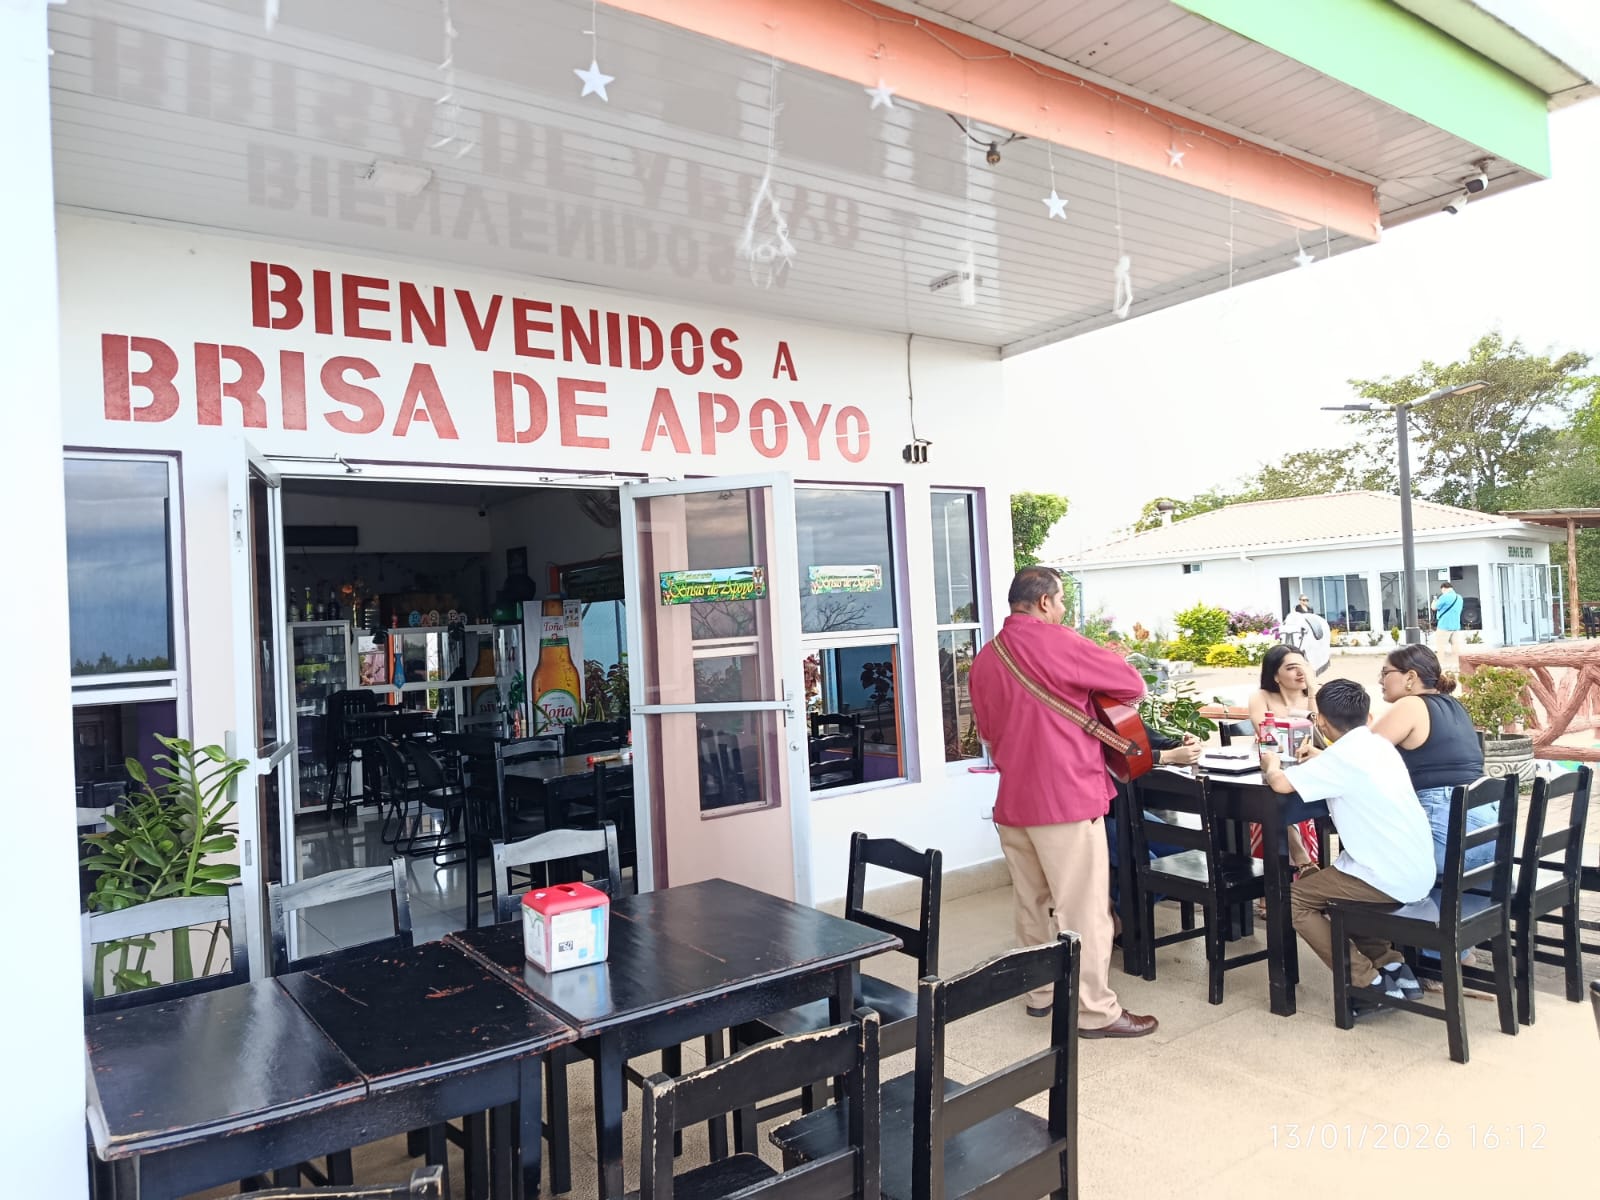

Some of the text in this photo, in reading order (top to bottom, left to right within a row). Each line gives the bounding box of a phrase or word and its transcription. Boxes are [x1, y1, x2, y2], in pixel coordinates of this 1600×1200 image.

[251, 261, 798, 381] BIENVENIDOS A
[101, 333, 871, 463] BRISA DE APOYO
[543, 703, 573, 719] Toña
